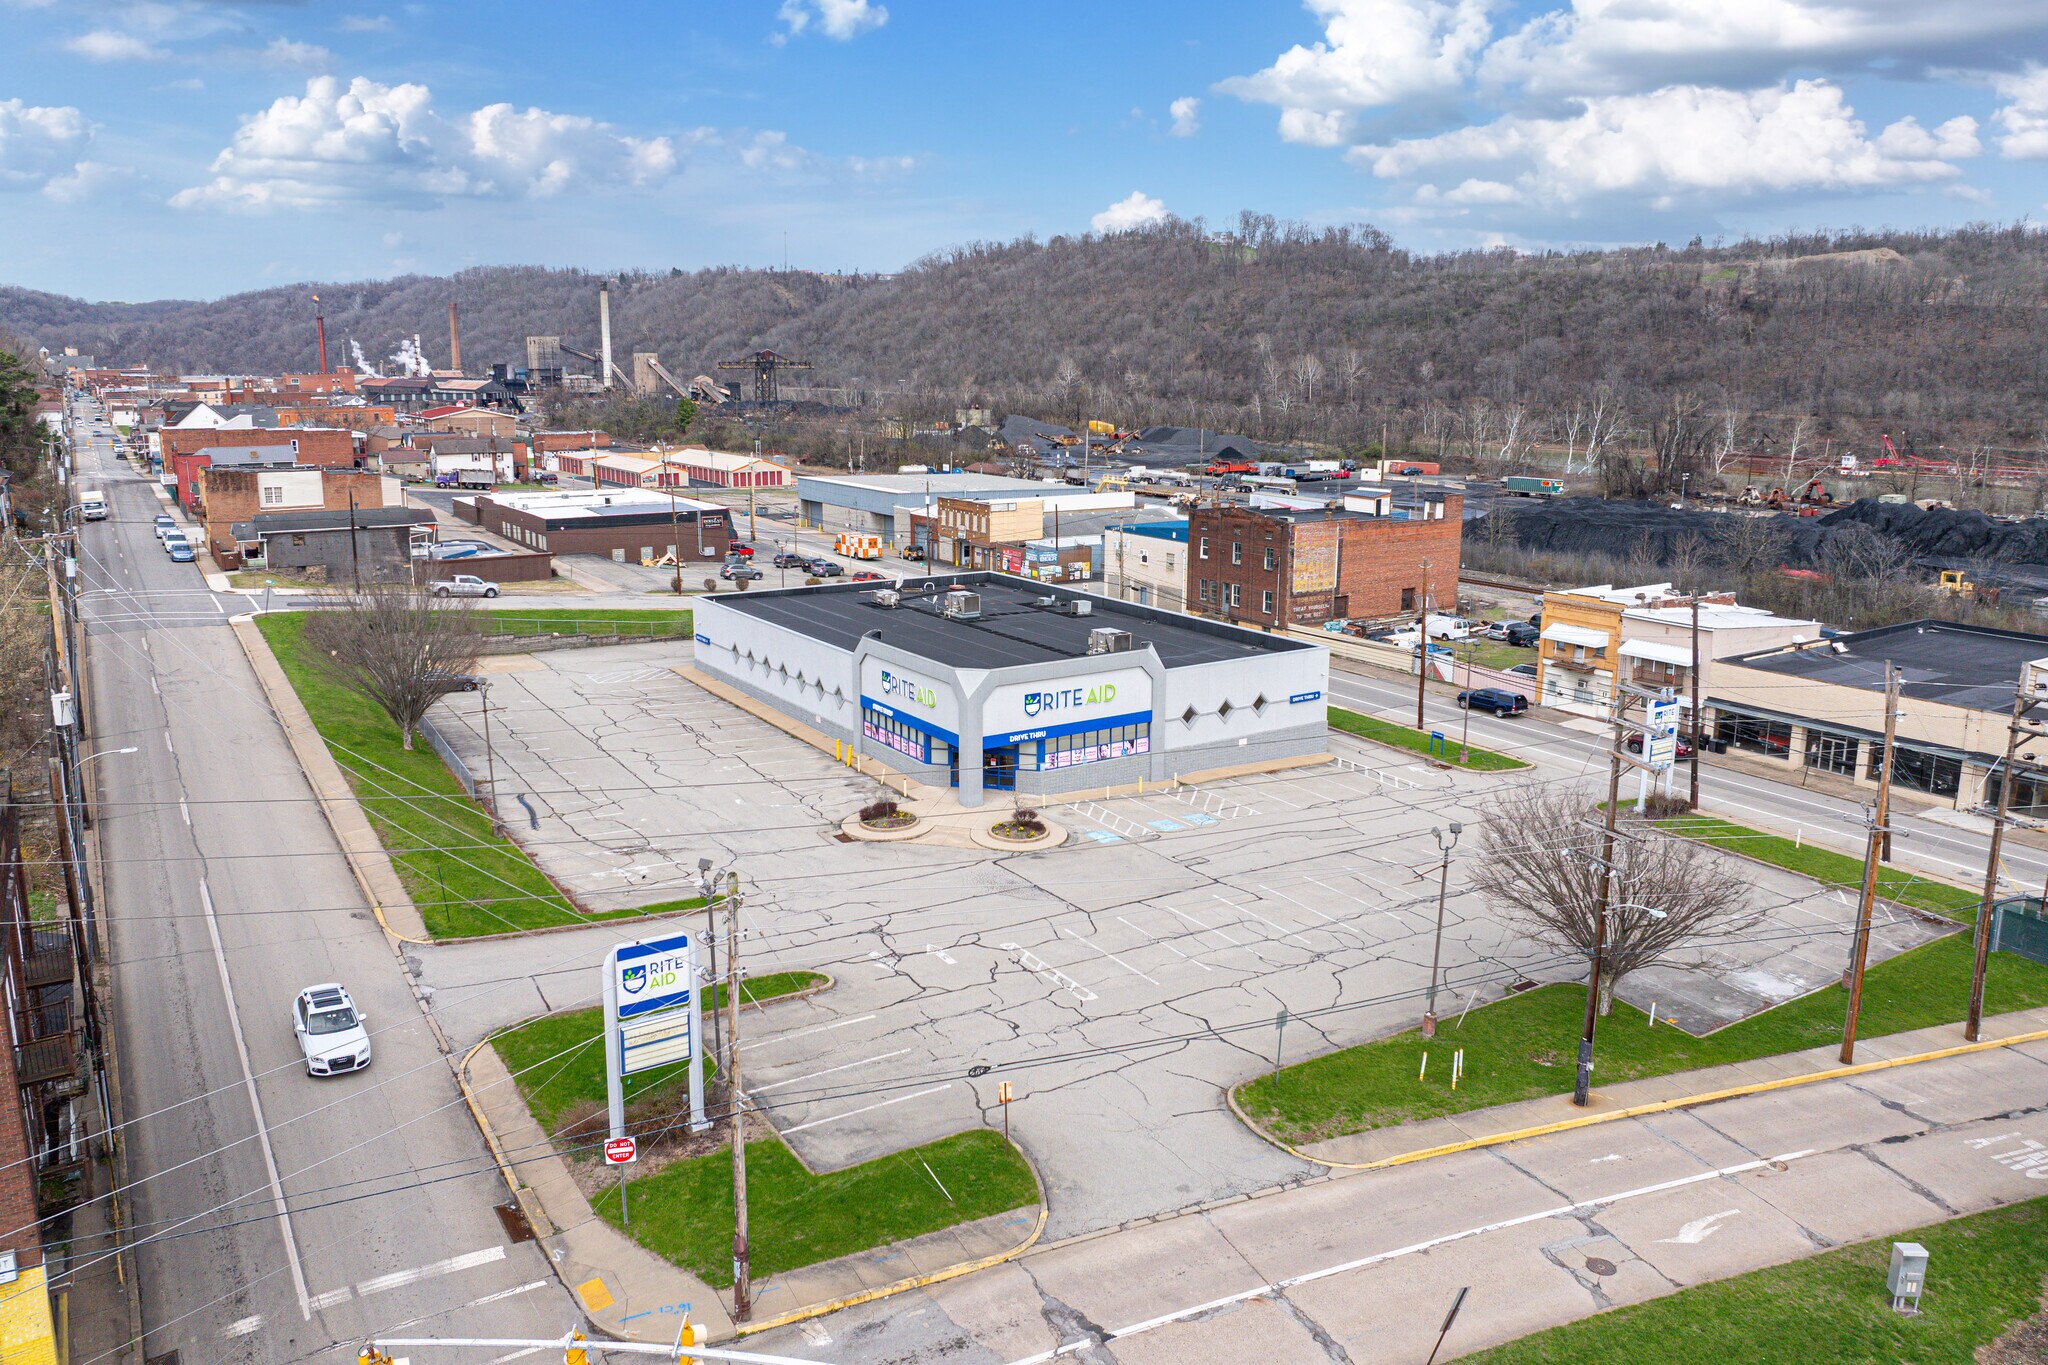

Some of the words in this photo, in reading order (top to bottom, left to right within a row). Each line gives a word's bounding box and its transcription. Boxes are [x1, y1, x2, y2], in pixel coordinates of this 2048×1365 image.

[892, 676, 915, 700] RITE
[916, 686, 936, 708] AID
[1043, 688, 1083, 711] RITE
[1086, 684, 1116, 704] AID
[1009, 733, 1028, 742] DRIVE
[1030, 731, 1046, 739] THRU
[650, 957, 684, 975] RITE
[649, 971, 676, 989] AID
